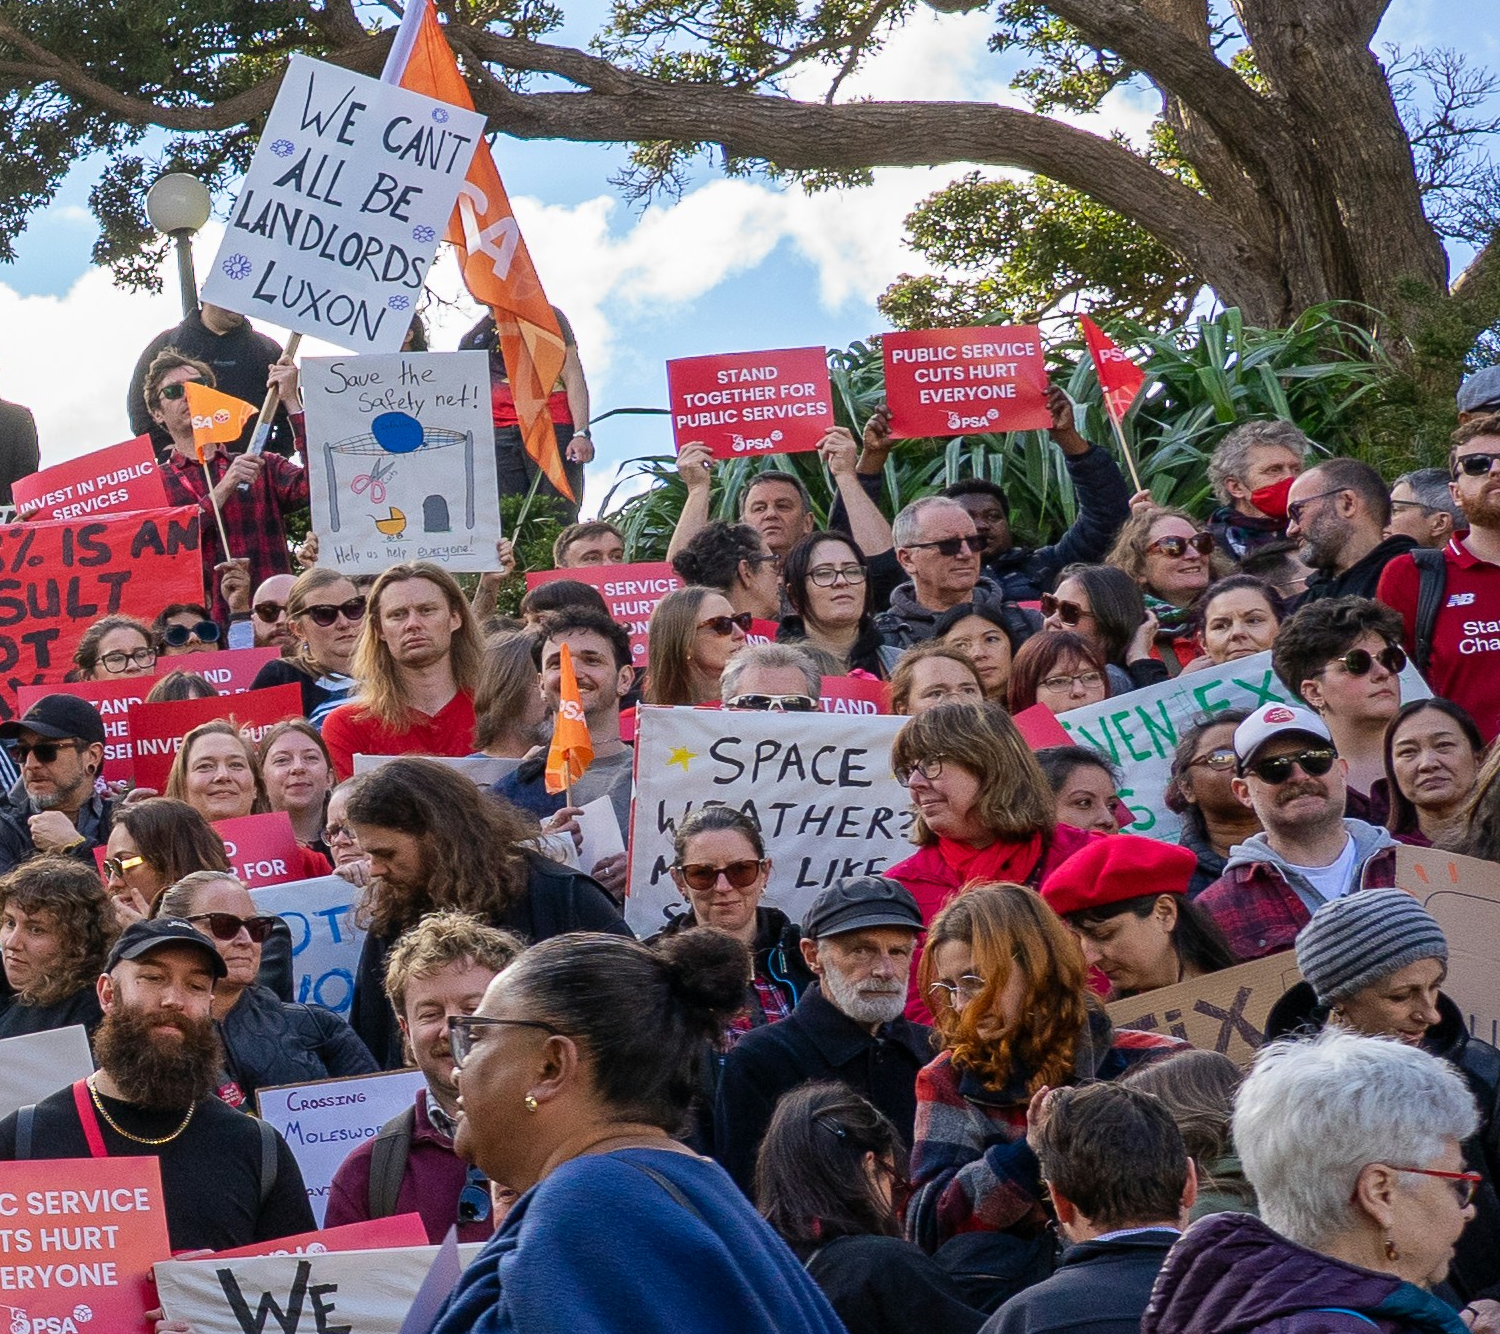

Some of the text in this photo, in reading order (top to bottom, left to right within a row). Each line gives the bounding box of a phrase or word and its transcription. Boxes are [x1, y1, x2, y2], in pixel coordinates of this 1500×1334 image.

[300, 71, 471, 174] WE CAN'T
[273, 147, 423, 222] ALL BE
[234, 190, 424, 289] LANDLORDS
[252, 260, 386, 341] LUXON
[892, 342, 1035, 364] PUBLIC SERVICE
[325, 361, 436, 394] Save the
[717, 367, 778, 384] STAND
[914, 363, 1018, 383] CUTS HURT
[435, 385, 478, 410] net!
[683, 383, 815, 408] TOGETHER FOR
[920, 384, 1016, 404] EVERYONE
[677, 402, 827, 428] PUBLIC SERVICES
[962, 416, 989, 429] PSA
[746, 436, 773, 449] PSA
[19, 462, 153, 513] INVEST IN PUBLIC
[52, 489, 129, 520] SERVICES
[62, 523, 111, 566] IS
[130, 518, 200, 557] AN
[334, 547, 359, 564] Help
[604, 579, 678, 596] SERVICE
[820, 697, 877, 714] TAND
[709, 737, 872, 786] SPACE
[244, 859, 288, 879] FOR
[287, 1091, 366, 1111] CROSSING
[27, 1188, 151, 1214] SERVICE
[40, 1226, 119, 1251] HURT
